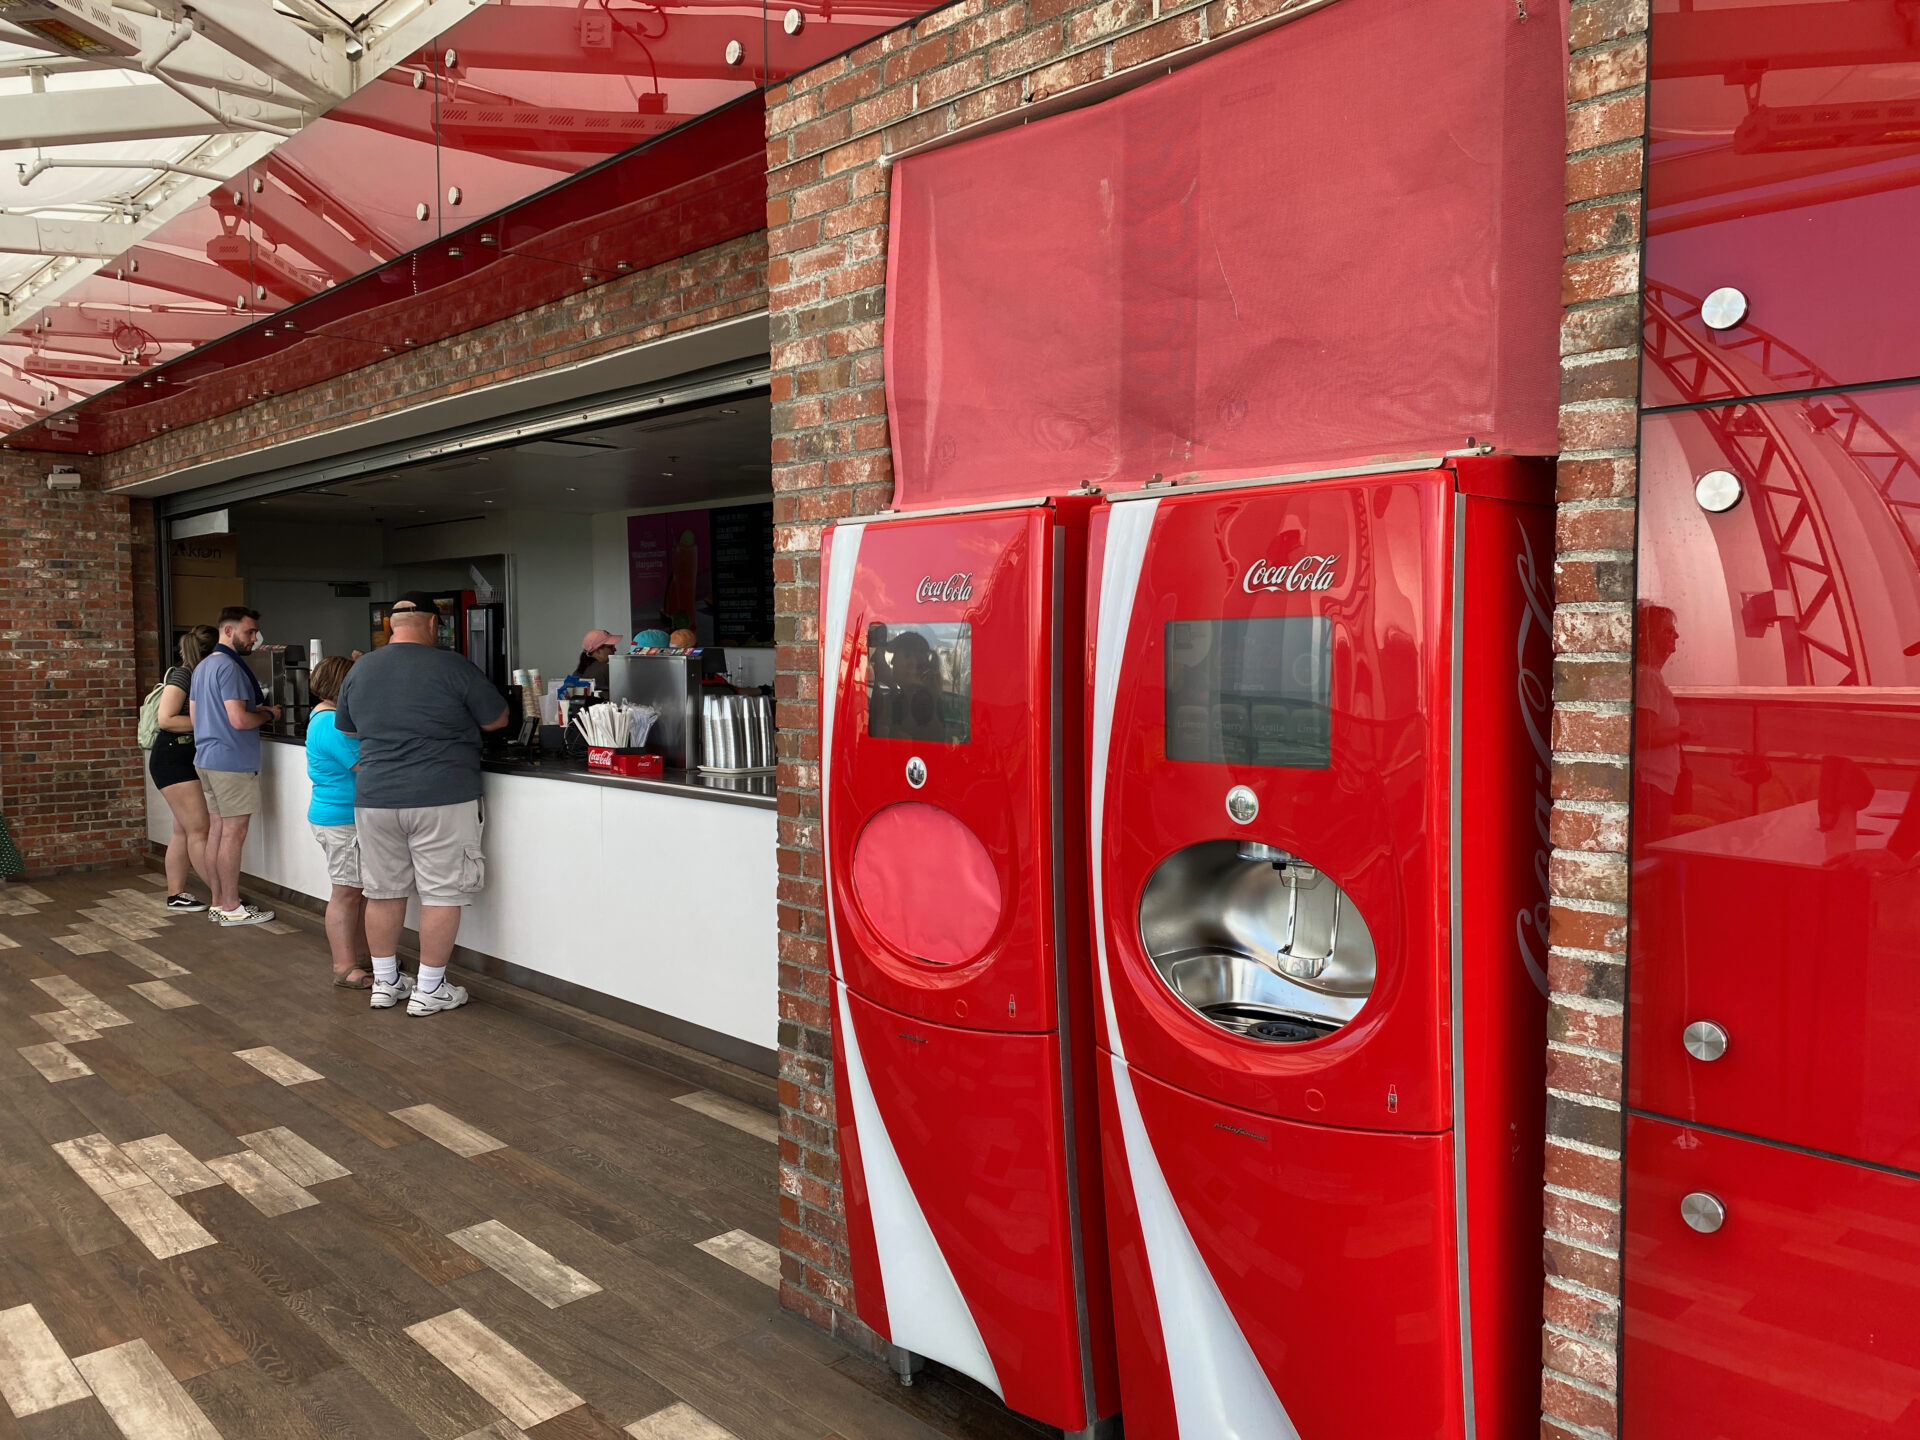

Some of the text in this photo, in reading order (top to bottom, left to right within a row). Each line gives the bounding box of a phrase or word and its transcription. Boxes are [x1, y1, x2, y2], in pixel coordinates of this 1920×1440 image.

[915, 572, 974, 604] Coca-Cola
[1243, 553, 1340, 594] Coca-Cola
[588, 749, 614, 766] Coca-Cola
[1516, 516, 1554, 1002] Coca-Cl
